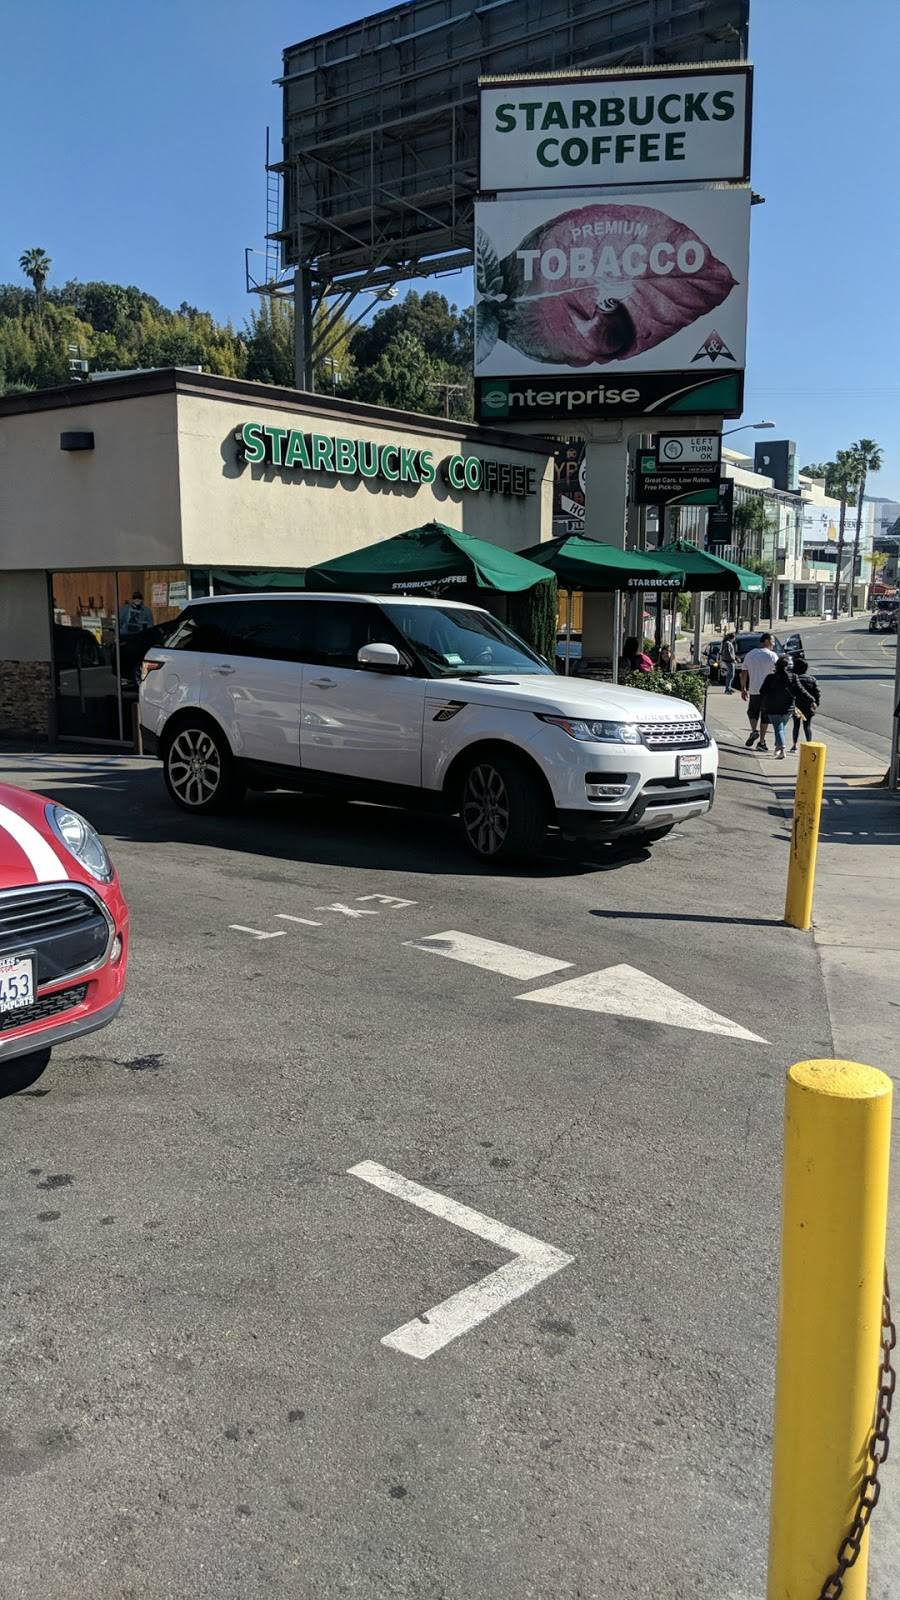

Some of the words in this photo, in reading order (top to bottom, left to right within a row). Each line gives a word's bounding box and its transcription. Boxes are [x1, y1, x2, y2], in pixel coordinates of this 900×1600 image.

[495, 91, 735, 133] STARBUCKS
[536, 132, 687, 168] COFFEE
[571, 220, 649, 242] PREMIUM
[516, 241, 706, 282] TOBACCO
[482, 385, 641, 411] enterprise
[690, 438, 713, 446] LEFT
[241, 422, 436, 485] STARBUCKS
[448, 454, 537, 496] COFFEE
[645, 476, 661, 484] Great
[662, 476, 678, 484] Cars.
[679, 476, 692, 484] Low
[693, 476, 712, 484] Rates.
[627, 578, 681, 587] STARBUCKS
[228, 893, 419, 940] EXIT
